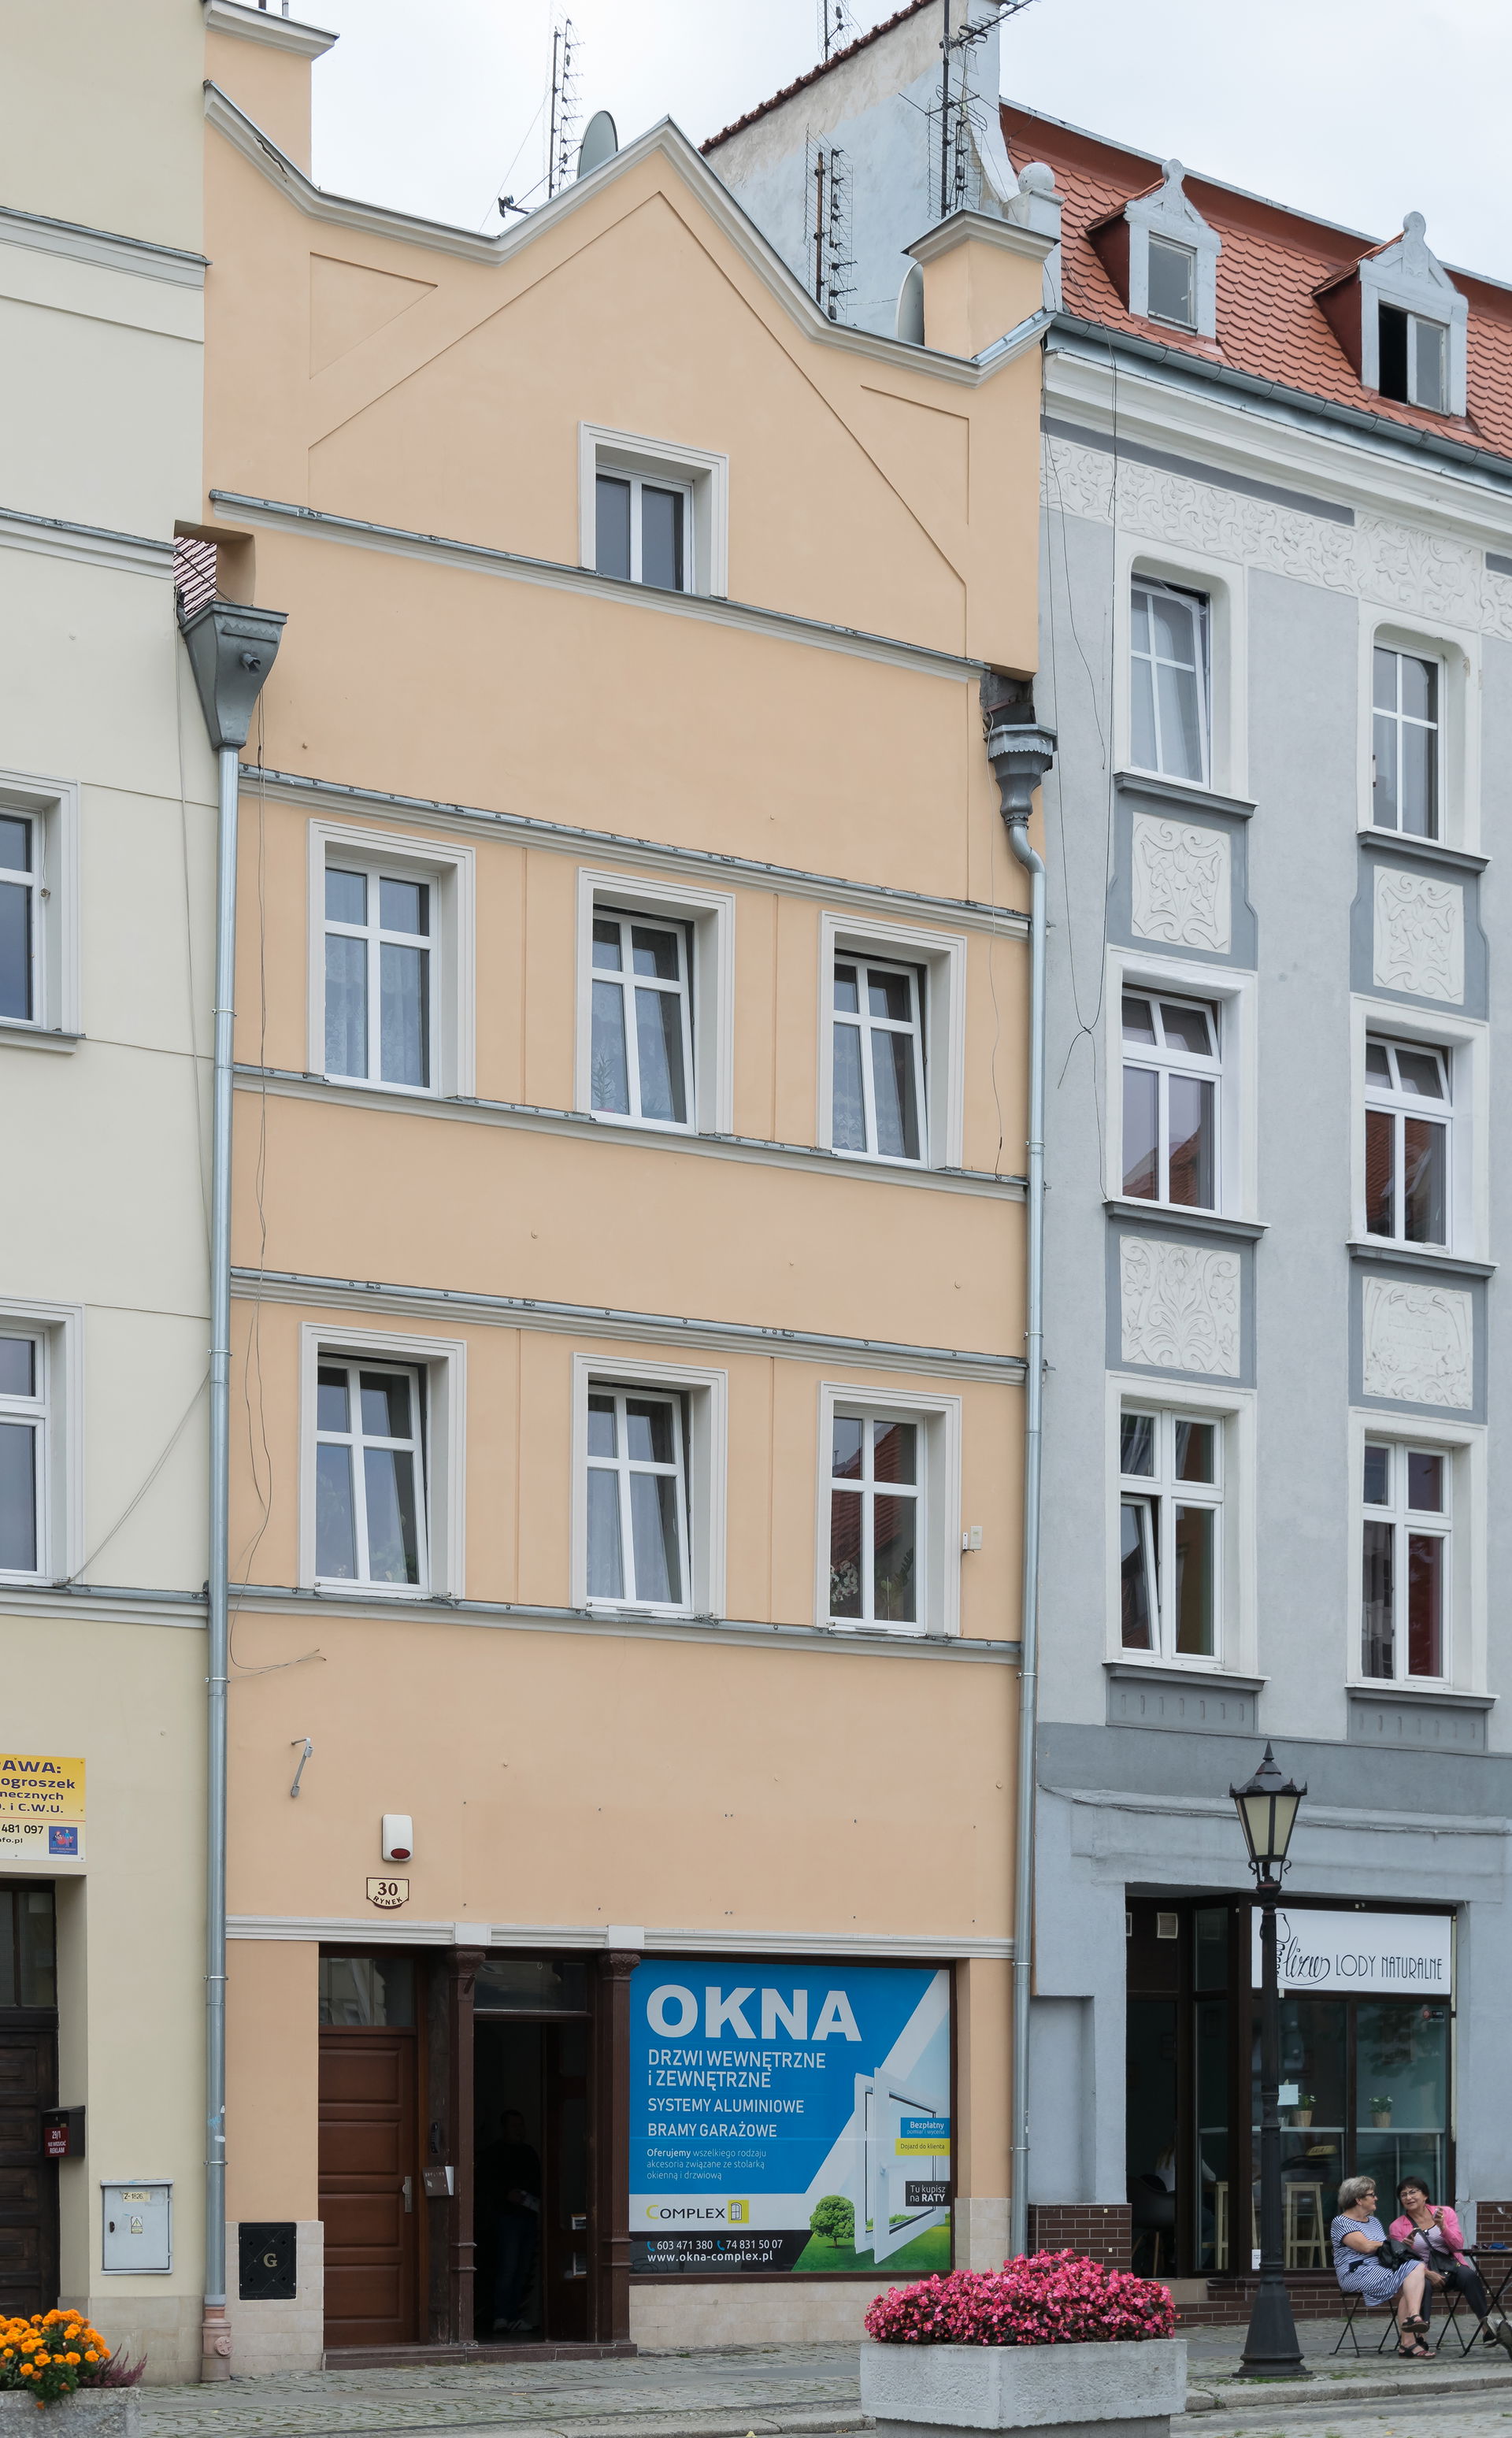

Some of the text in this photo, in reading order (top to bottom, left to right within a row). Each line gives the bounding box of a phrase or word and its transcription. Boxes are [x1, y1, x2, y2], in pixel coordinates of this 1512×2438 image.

[0, 1760, 61, 1774] AWA:
[1, 1778, 76, 1789] ogroszek
[18, 1803, 64, 1814] C.W.U.
[2, 1824, 43, 1834] 481 097
[378, 1882, 398, 1896] 30
[373, 1895, 402, 1905] RYNEK
[1336, 1954, 1376, 1977] LODY
[1381, 1956, 1442, 1980] NATURALNE
[647, 1984, 862, 2041] OKNA
[648, 2049, 826, 2071] DRZWI WEWNĘTRZNE
[648, 2070, 771, 2091] i ZEWNĘTRZNE
[648, 2098, 804, 2114] SYSTEMY ALUMINIOWE
[648, 2121, 777, 2137] BRAMY GARAŻOWE
[647, 2148, 766, 2158] Oferujemy wszelkiego rodzaju
[647, 2160, 684, 2169] akcesoria
[686, 2160, 721, 2169] związane
[734, 2160, 765, 2169] stolarką
[647, 2171, 722, 2180] okienną i drzwiową
[921, 2184, 946, 2194] kupisz
[646, 2204, 725, 2220] COMPLEX
[657, 2240, 783, 2250] 603 471 380 74 831 50 07
[264, 2253, 277, 2268] G
[647, 2251, 773, 2262] www.okna-complex.pl
